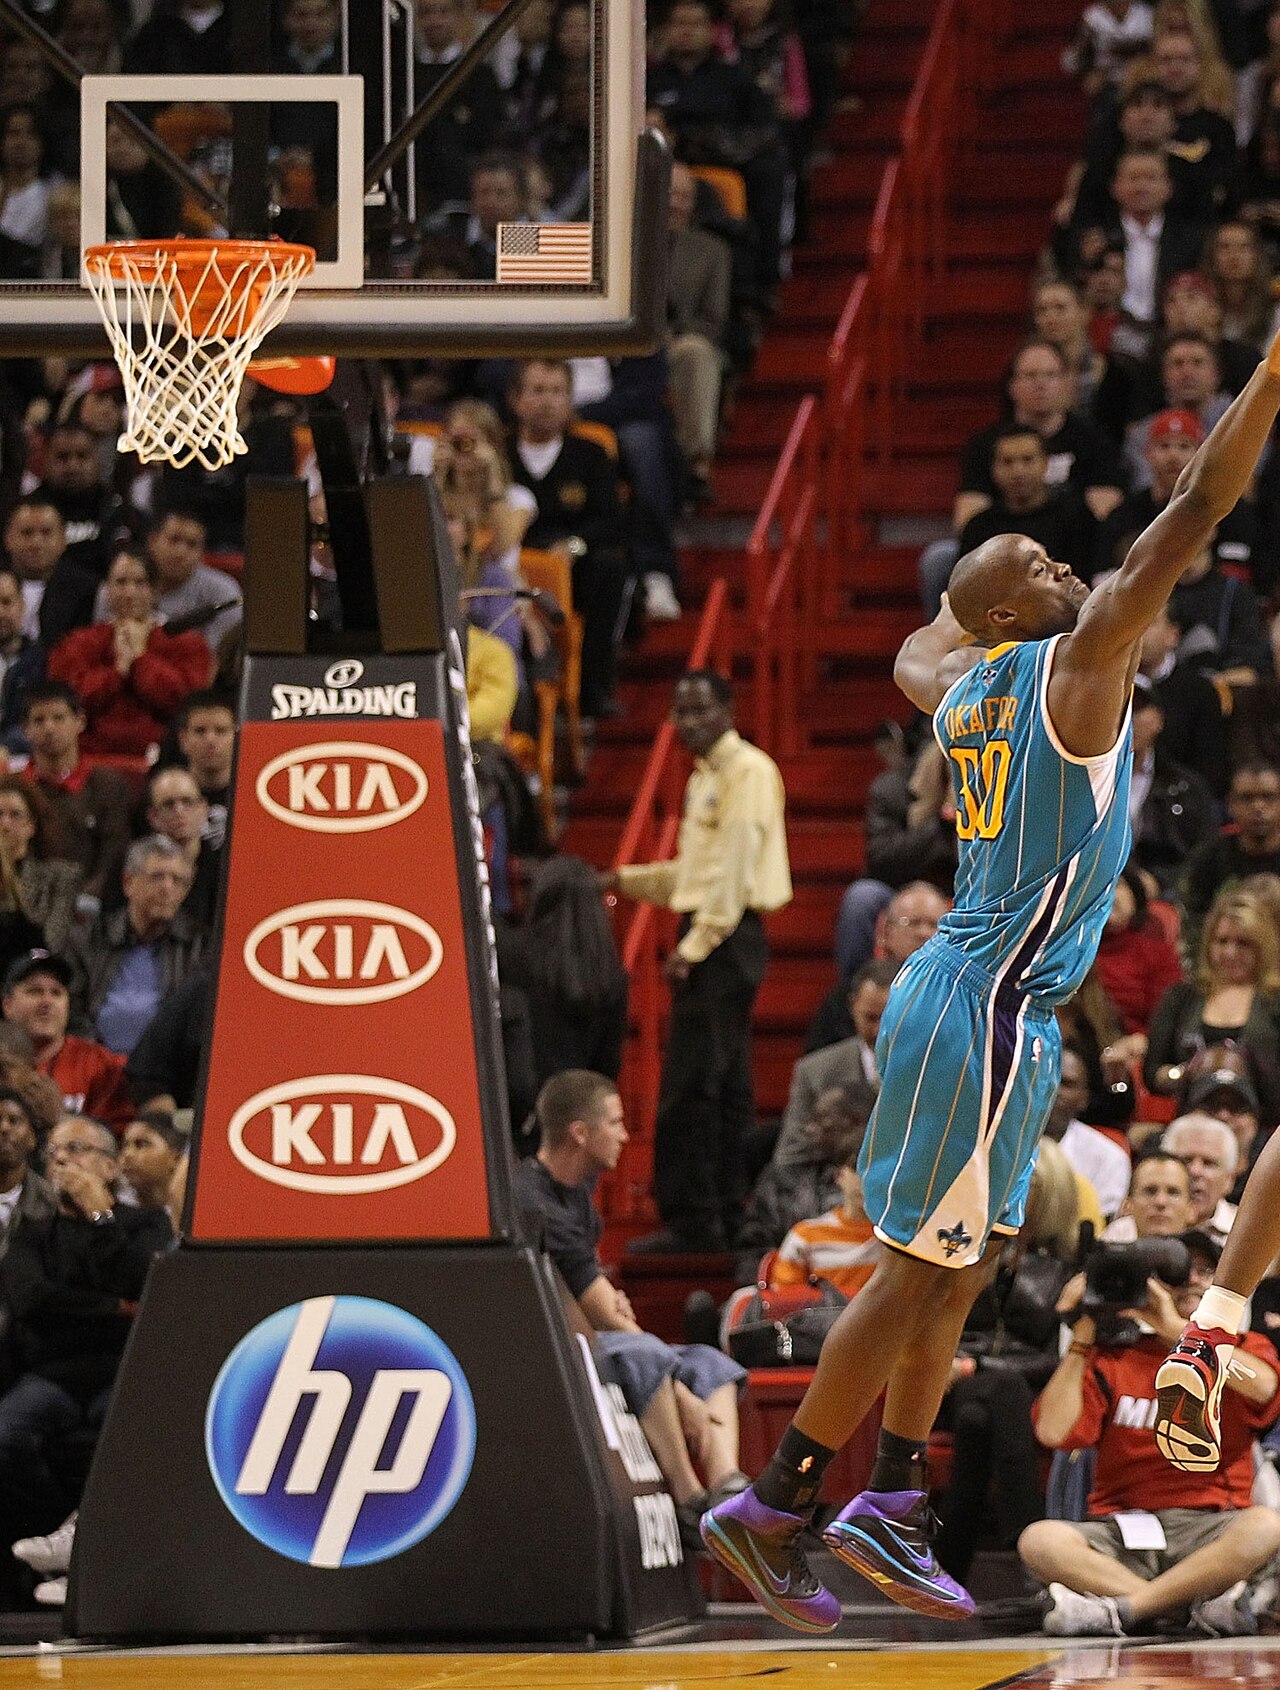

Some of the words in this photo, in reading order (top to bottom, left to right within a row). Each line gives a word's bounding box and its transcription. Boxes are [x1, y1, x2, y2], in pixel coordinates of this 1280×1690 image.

[271, 681, 417, 720] SPALDING
[288, 763, 401, 811] KIA
[949, 739, 1013, 841] 50
[281, 924, 411, 980] KIA
[271, 1103, 419, 1165] KIA
[235, 1295, 453, 1569] hp
